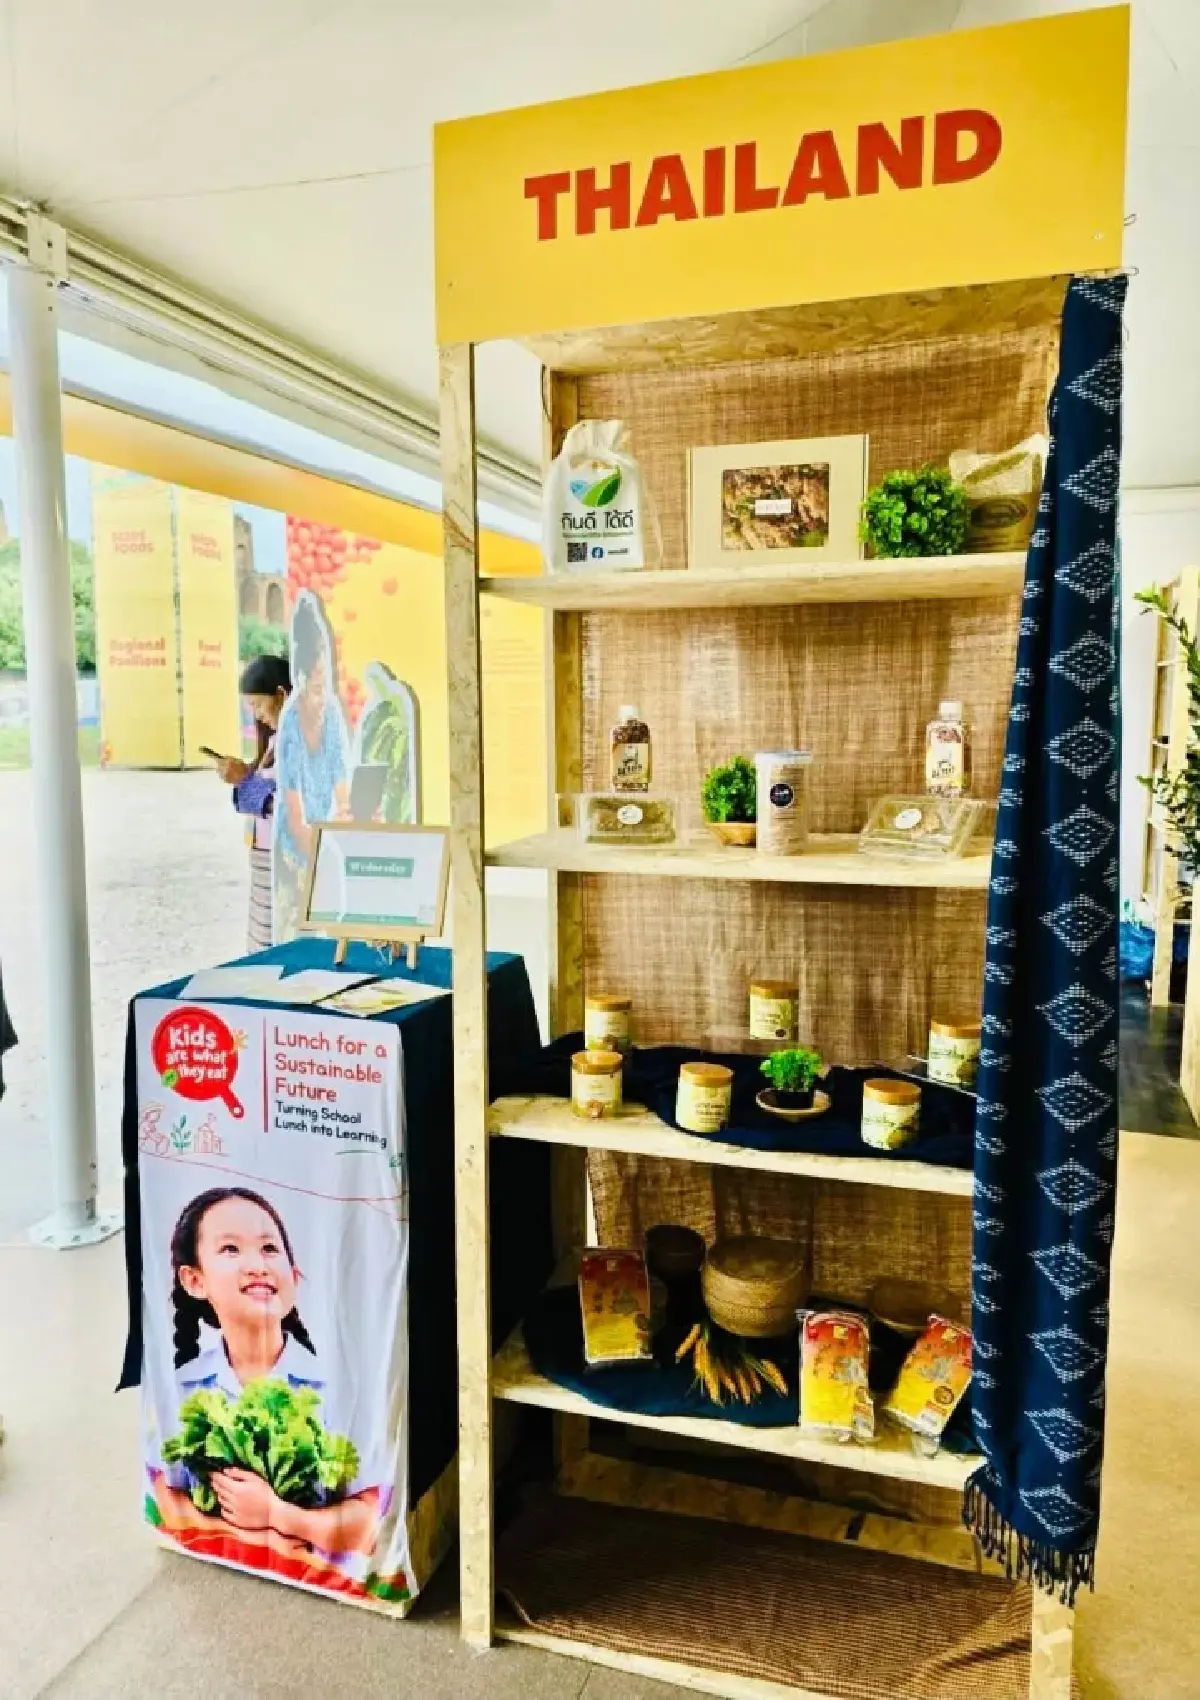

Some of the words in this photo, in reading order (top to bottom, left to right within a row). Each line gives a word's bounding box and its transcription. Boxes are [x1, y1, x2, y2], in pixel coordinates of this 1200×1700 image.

[524, 108, 1003, 242] THAILAND
[169, 1024, 217, 1049] Kids
[274, 1025, 330, 1051] Lunch
[337, 1034, 367, 1055] for
[375, 1044, 387, 1058] a
[166, 1049, 188, 1065] are
[192, 1048, 227, 1064] what
[275, 1053, 382, 1083] Sustainable
[178, 1064, 206, 1084] they
[207, 1063, 228, 1081] eat
[275, 1077, 337, 1102] Future
[275, 1100, 319, 1121] Turning
[320, 1107, 362, 1124] School
[275, 1117, 308, 1132] Lunch
[311, 1124, 333, 1137] into
[336, 1125, 387, 1150] Learning
